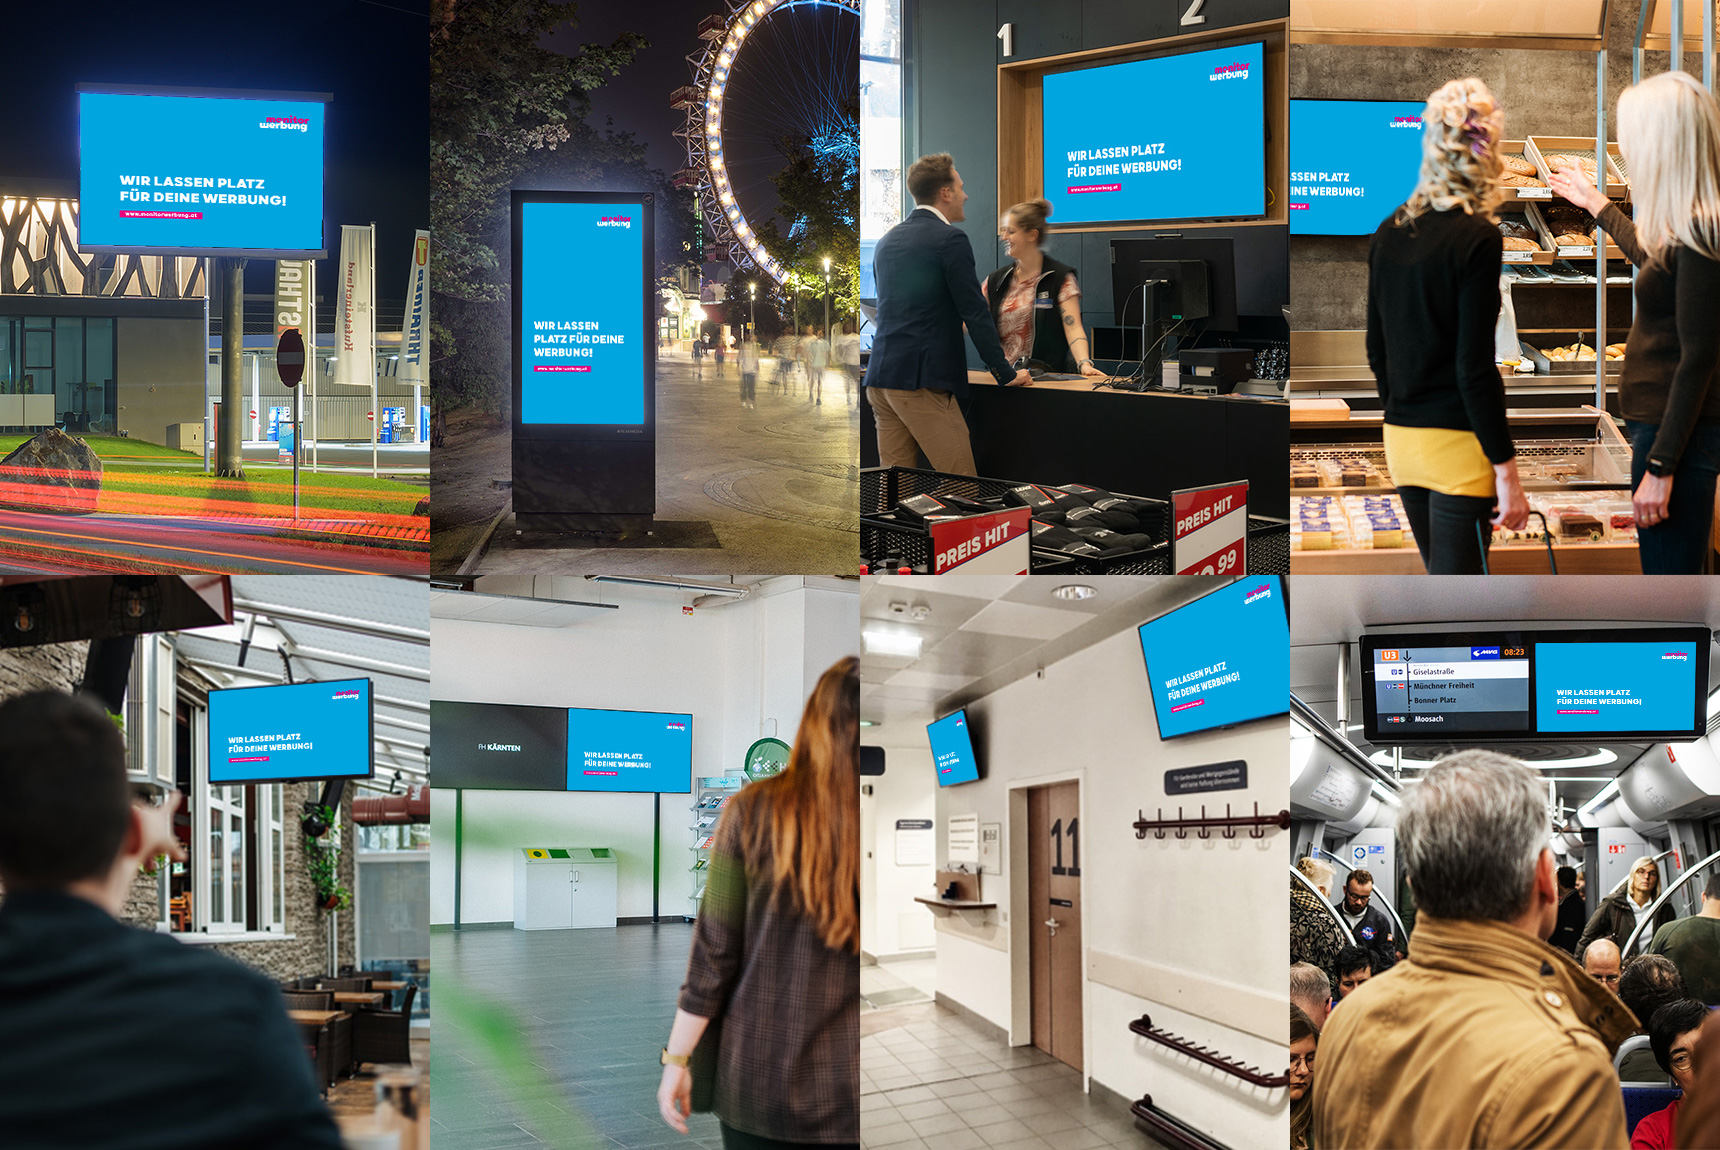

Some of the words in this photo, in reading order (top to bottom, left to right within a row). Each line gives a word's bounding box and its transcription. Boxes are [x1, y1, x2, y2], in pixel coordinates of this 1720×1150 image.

[1180, 0, 1206, 26] 2
[997, 23, 1013, 57] 1
[1214, 62, 1250, 74] monitor
[1210, 70, 1248, 82] werbung
[266, 116, 310, 124] monitor
[1390, 120, 1422, 130] werbung
[260, 121, 308, 132] werbung
[1067, 150, 1087, 162] WIR
[1088, 146, 1129, 160] LASSEN
[1131, 143, 1166, 157] PLATZ
[1067, 163, 1087, 178] FÜR
[1088, 164, 1120, 176] DEINE
[1121, 159, 1182, 174] WERBUNG!
[120, 175, 150, 186] WIR
[154, 176, 214, 188] LASSEN
[218, 178, 265, 189] PLATZ
[1290, 172, 1316, 182] SSEN
[1319, 173, 1350, 182] PLATZ
[120, 188, 150, 202] FÜR
[154, 192, 200, 203] DEINE
[202, 194, 286, 206] WERBUNG!
[1309, 187, 1364, 197] WERBUNG!
[597, 220, 630, 228] werbung
[534, 321, 555, 330] WIR
[558, 322, 599, 331] LASSEN
[534, 335, 567, 344] PLATZ
[569, 332, 590, 344] FÜR
[592, 335, 624, 344] DEINE
[534, 348, 593, 358] WERBUNG!
[1177, 510, 1211, 536] PREIS
[1214, 495, 1233, 518] HIT
[936, 536, 982, 572] PREIS
[985, 521, 1010, 548] HIT
[1218, 549, 1237, 574] 99
[1244, 590, 1271, 604] werbung
[1384, 652, 1396, 660] U3
[1504, 648, 1524, 656] 08:23
[1166, 678, 1178, 688] WIR
[1178, 668, 1204, 684] LASSEN
[1204, 661, 1226, 678] PLATZ
[1413, 668, 1454, 676] Giselastraße
[1168, 690, 1181, 700] FÜR
[1181, 684, 1200, 698] DEINE
[1200, 671, 1240, 691] WERBUNG!
[1414, 682, 1446, 690] Münchner
[1440, 696, 1456, 704] Platz
[1599, 698, 1642, 706] WERBUNG!
[228, 736, 244, 744] WIR
[244, 734, 274, 742] LASSEN
[244, 744, 268, 752] DEINE
[269, 742, 312, 751] WERBUNG!
[487, 743, 520, 752] KÄRNTEN
[1051, 817, 1080, 877] 11
